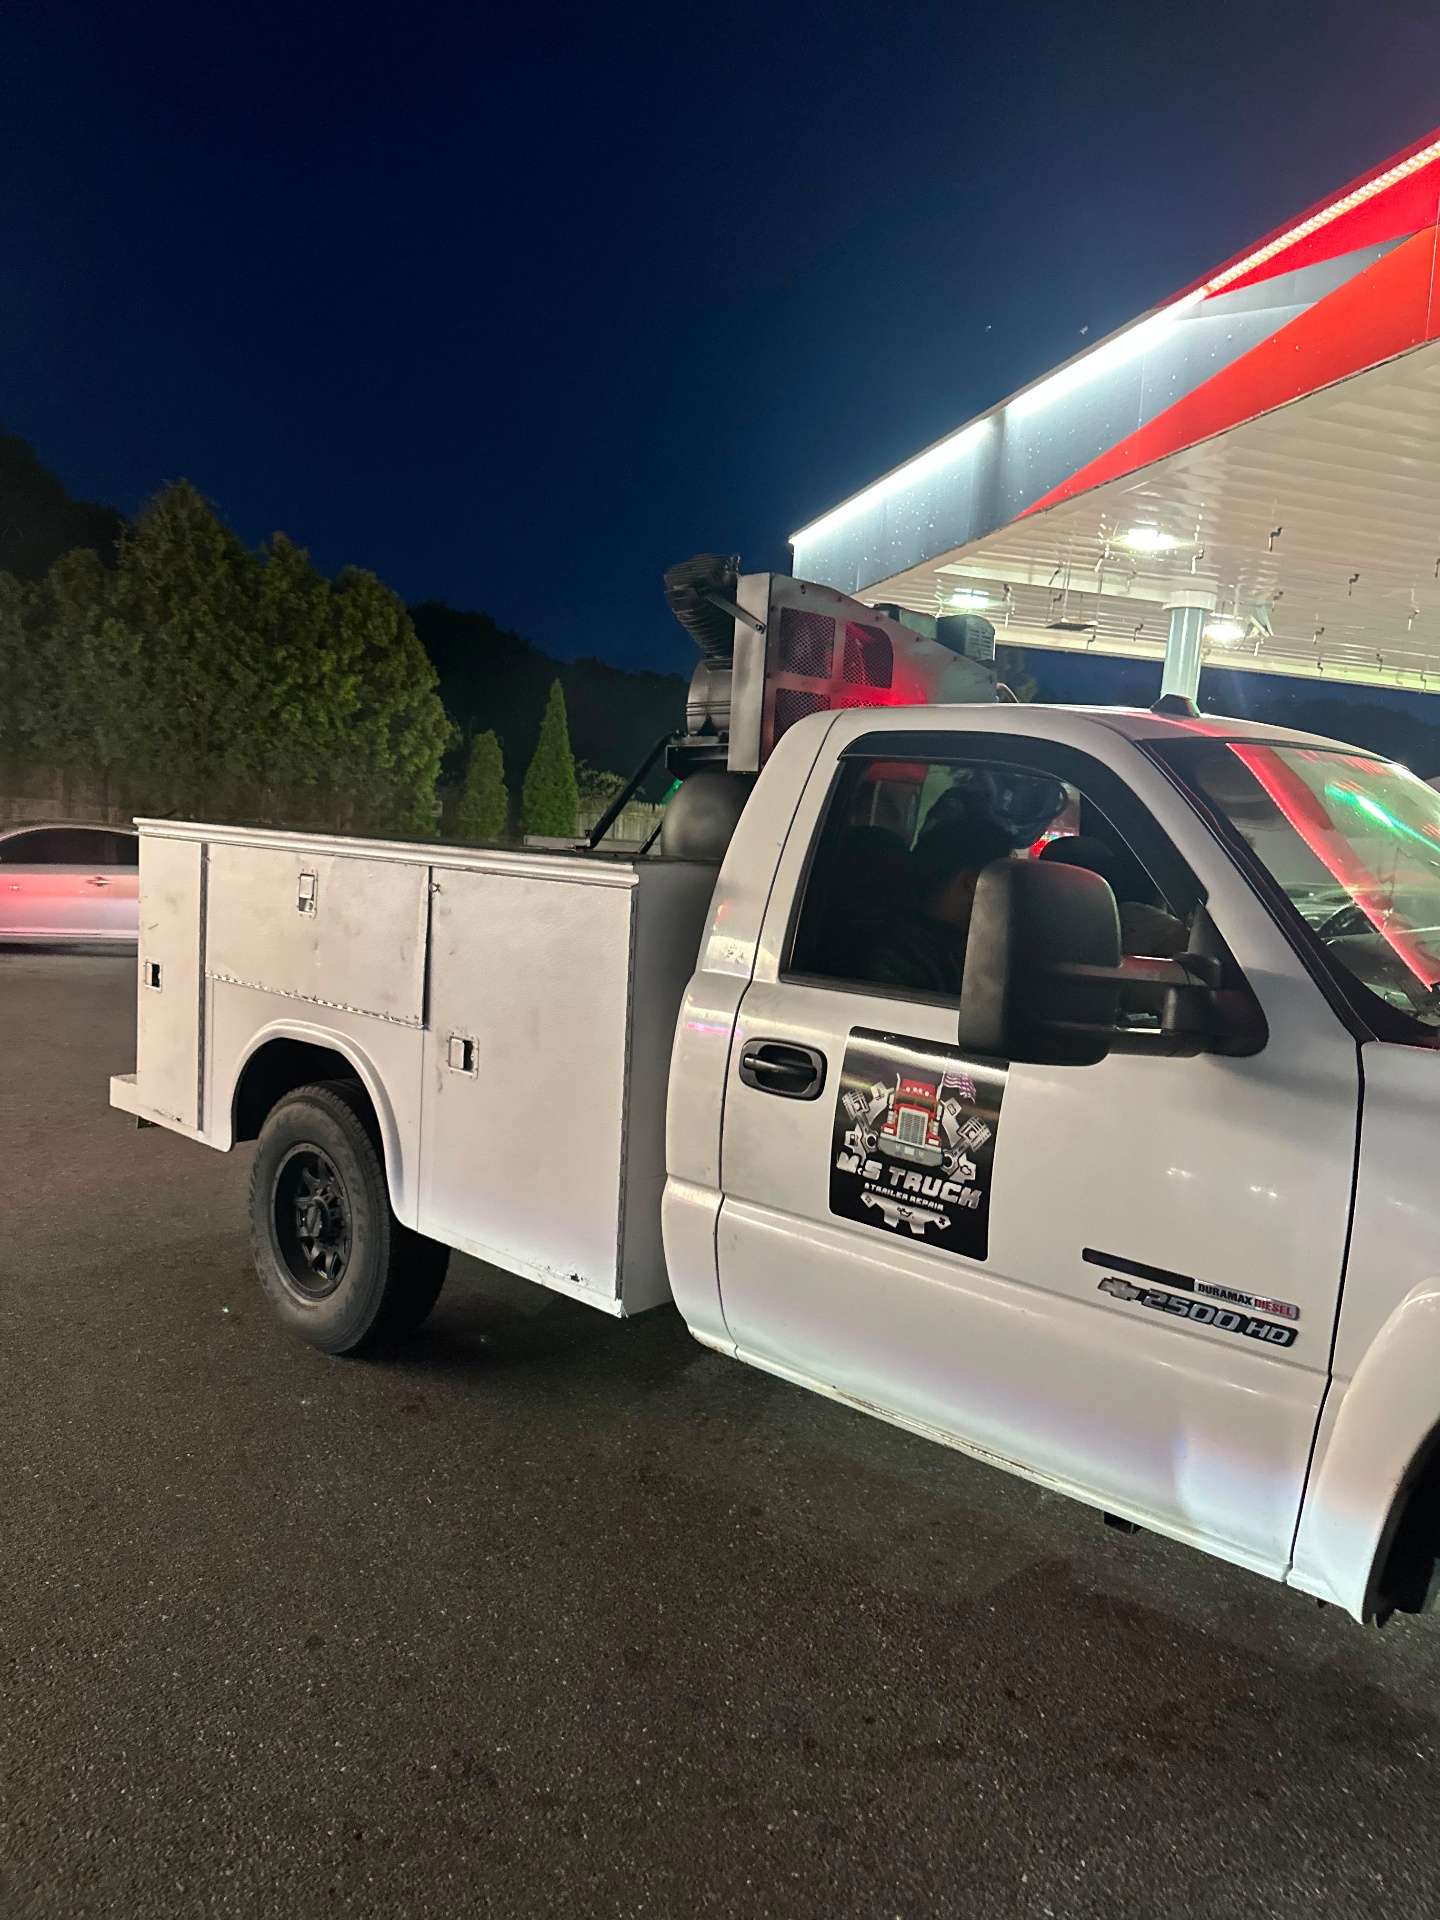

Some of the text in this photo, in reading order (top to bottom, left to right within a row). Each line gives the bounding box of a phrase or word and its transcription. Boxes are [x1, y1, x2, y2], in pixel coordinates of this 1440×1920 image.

[871, 1183, 909, 1201] TRAILER
[909, 1195, 944, 1211] REPAIR
[888, 1165, 983, 1210] TRUCK
[1142, 1288, 1290, 1344] 2500 HD
[1197, 1283, 1292, 1317] DURAMAX DIESEL
